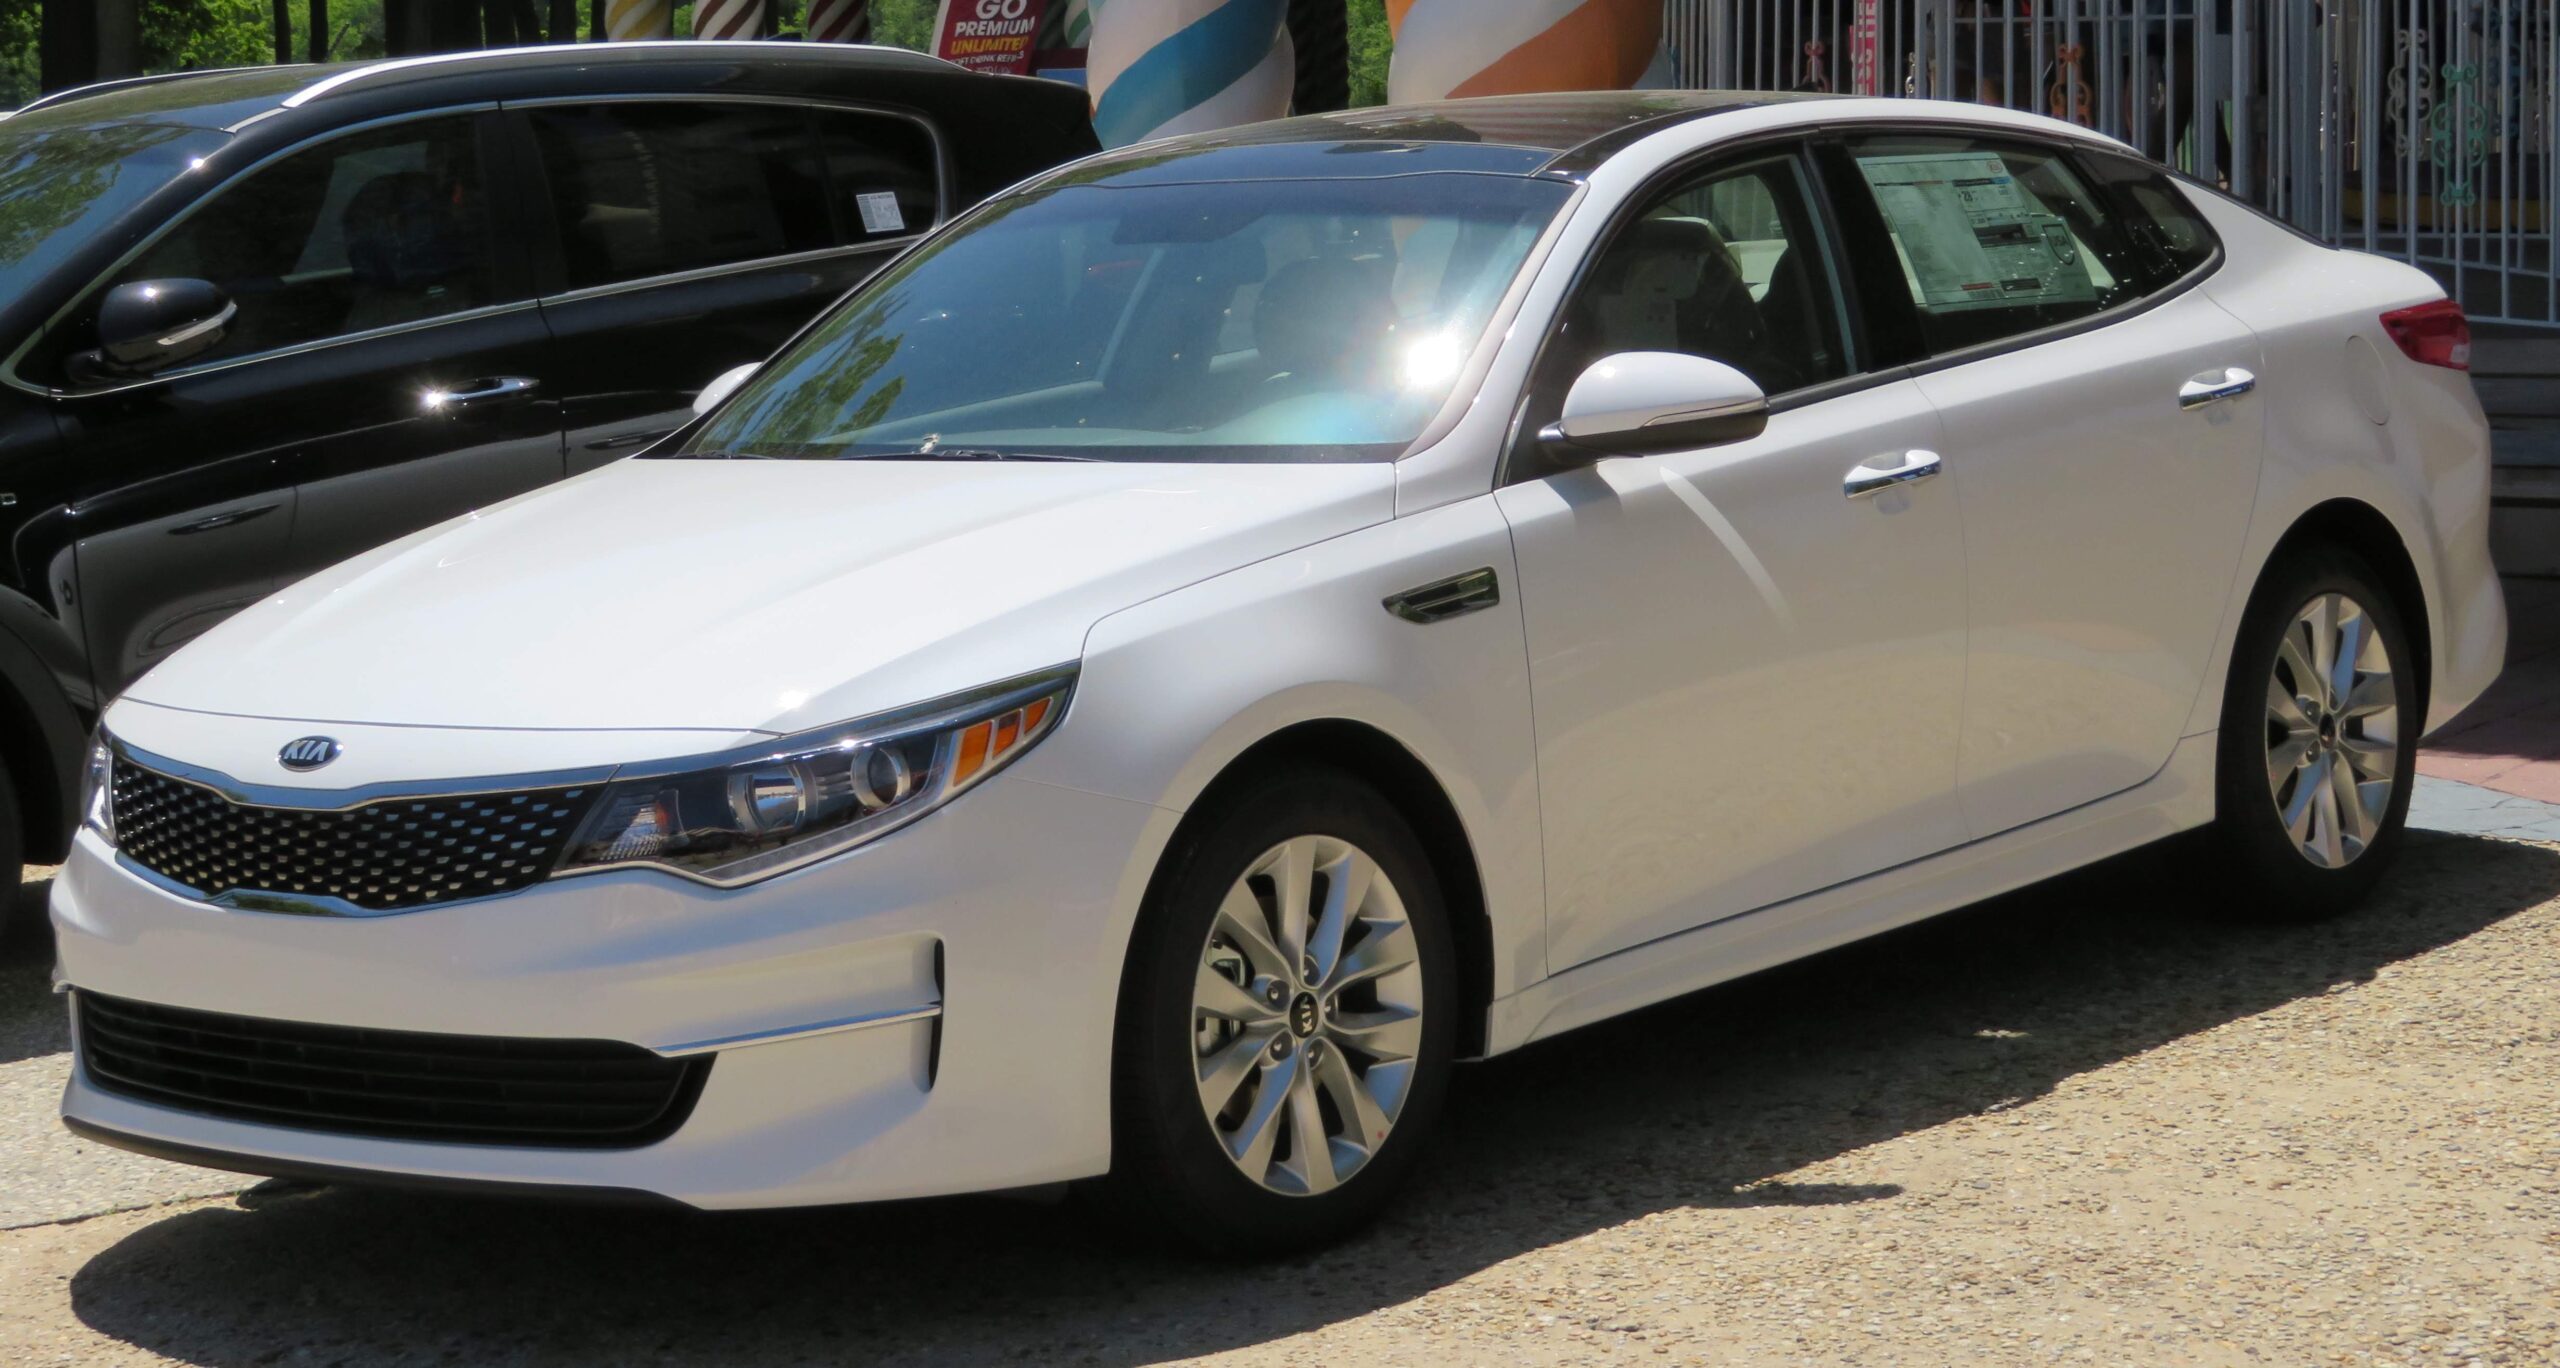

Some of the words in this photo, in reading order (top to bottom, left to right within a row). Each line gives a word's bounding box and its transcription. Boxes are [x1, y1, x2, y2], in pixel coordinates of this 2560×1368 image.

[975, 0, 1027, 19] GO
[954, 16, 1036, 37] PREMIUM
[970, 54, 995, 64] DRINK
[283, 740, 330, 762] KIA
